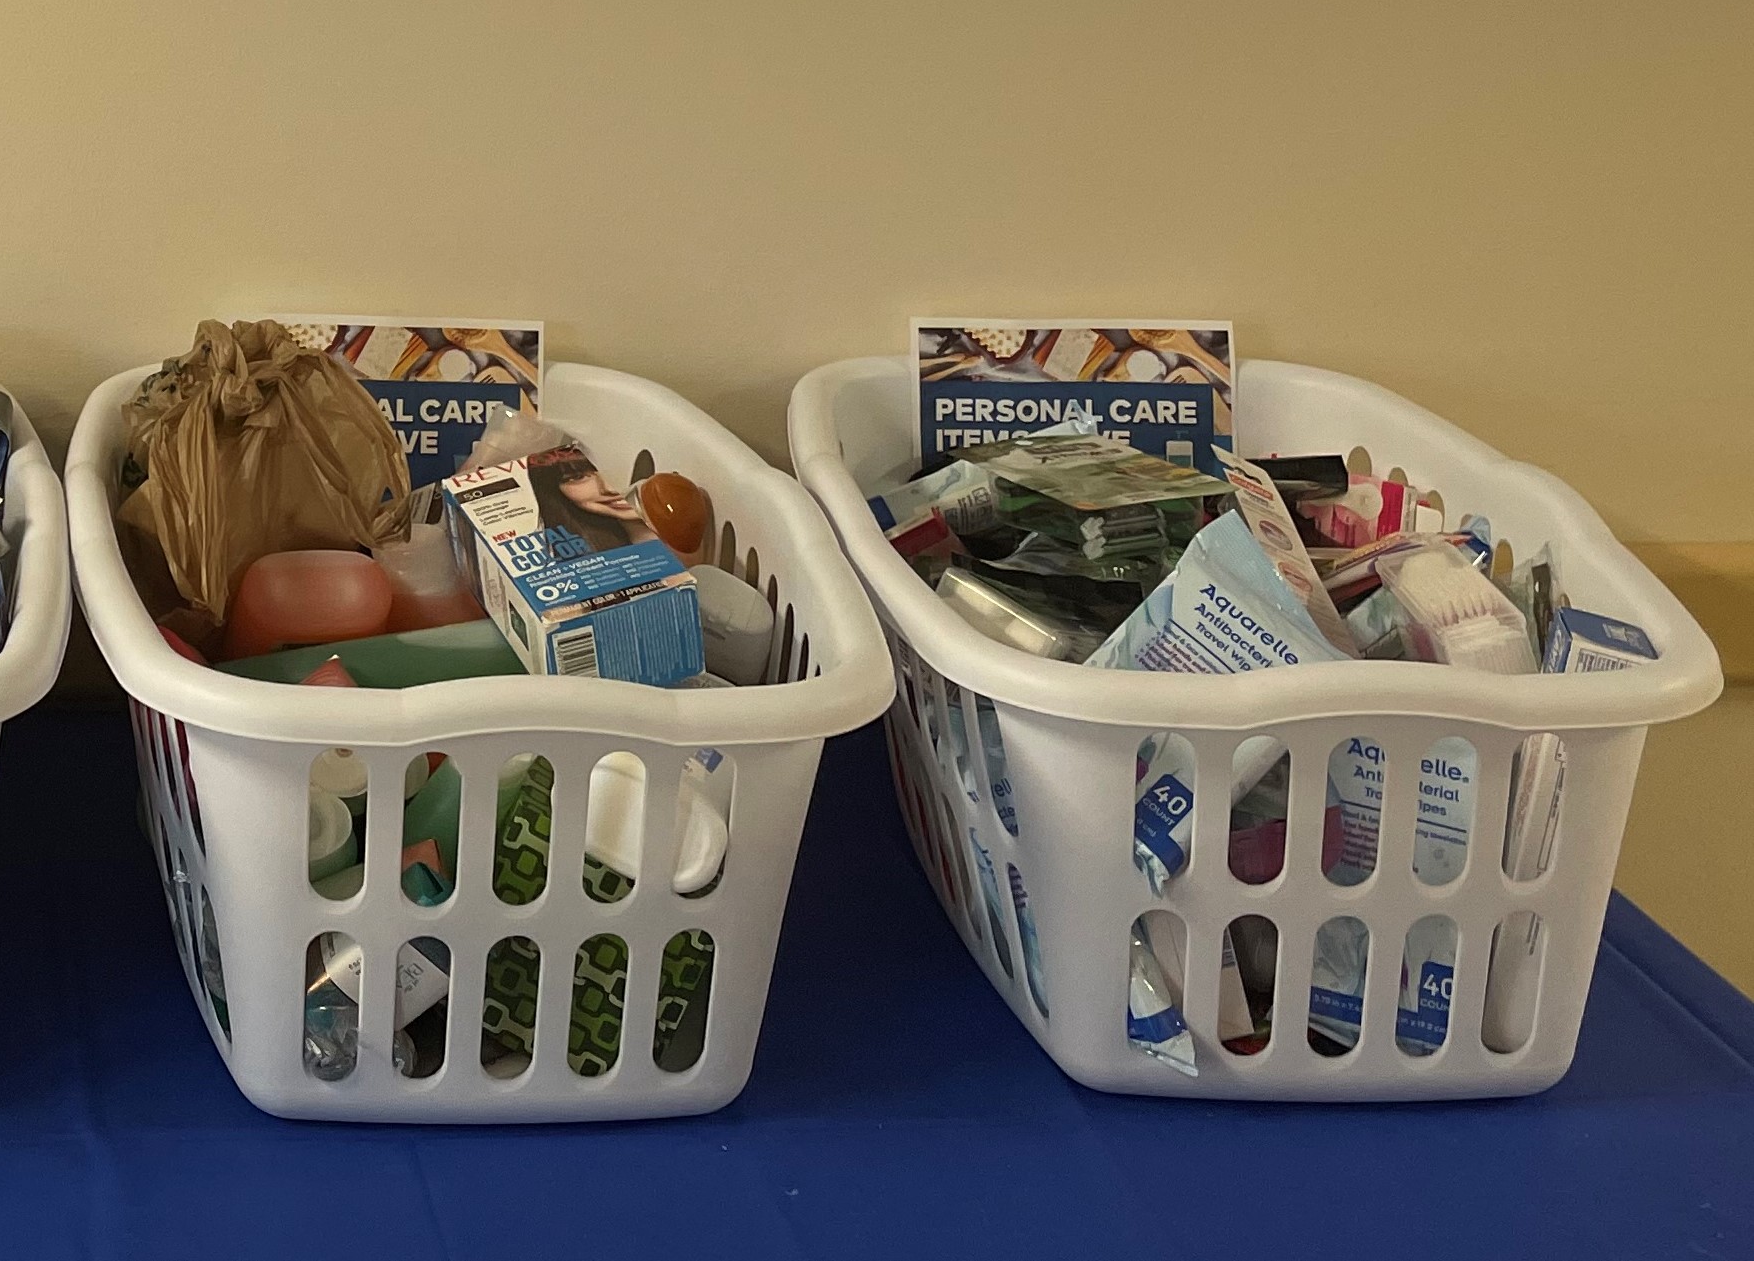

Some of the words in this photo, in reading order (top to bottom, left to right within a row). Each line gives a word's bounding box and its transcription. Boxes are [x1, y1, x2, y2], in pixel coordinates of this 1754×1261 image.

[935, 398, 1103, 423] PERSONAL
[1110, 399, 1197, 424] CARE
[464, 490, 484, 500] 50
[493, 530, 516, 543] NEW
[497, 525, 580, 557] TOTAL
[526, 567, 562, 583] CLEAN
[569, 556, 605, 569] VEGAN
[536, 580, 579, 601] 0%
[1196, 622, 1229, 652] Travel
[1200, 584, 1298, 665] Aquarelle
[1142, 798, 1175, 826] COUNT
[1153, 786, 1187, 815] 40
